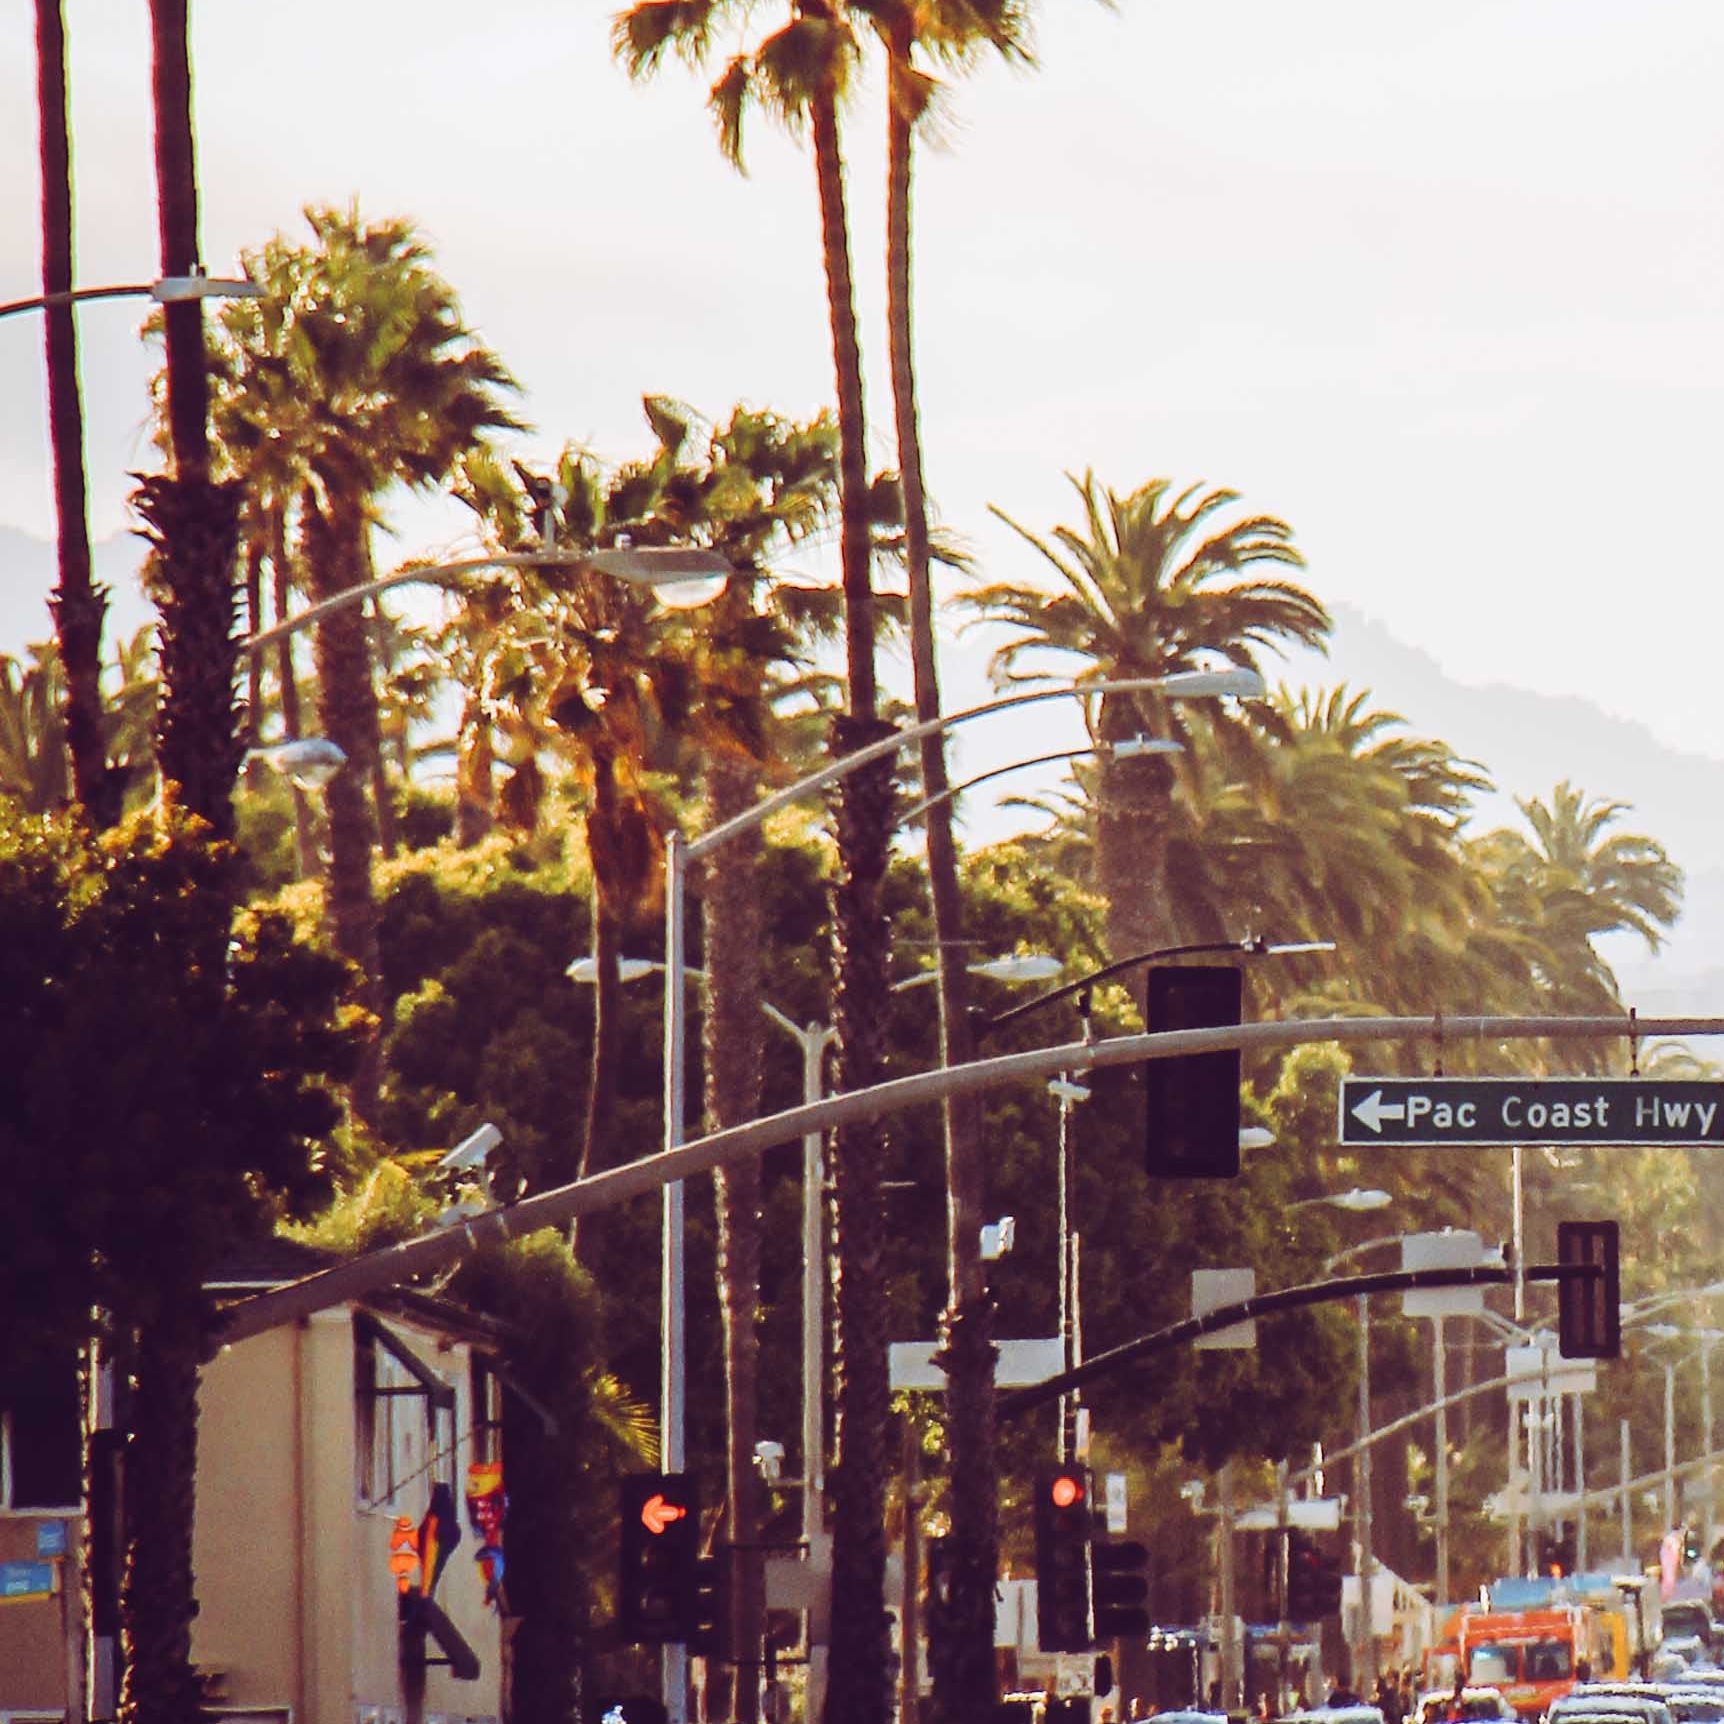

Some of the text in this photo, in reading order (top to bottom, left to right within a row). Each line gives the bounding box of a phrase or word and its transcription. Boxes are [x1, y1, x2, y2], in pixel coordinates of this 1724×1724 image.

[1406, 1095, 1718, 1137] Pac Coast Hwy
